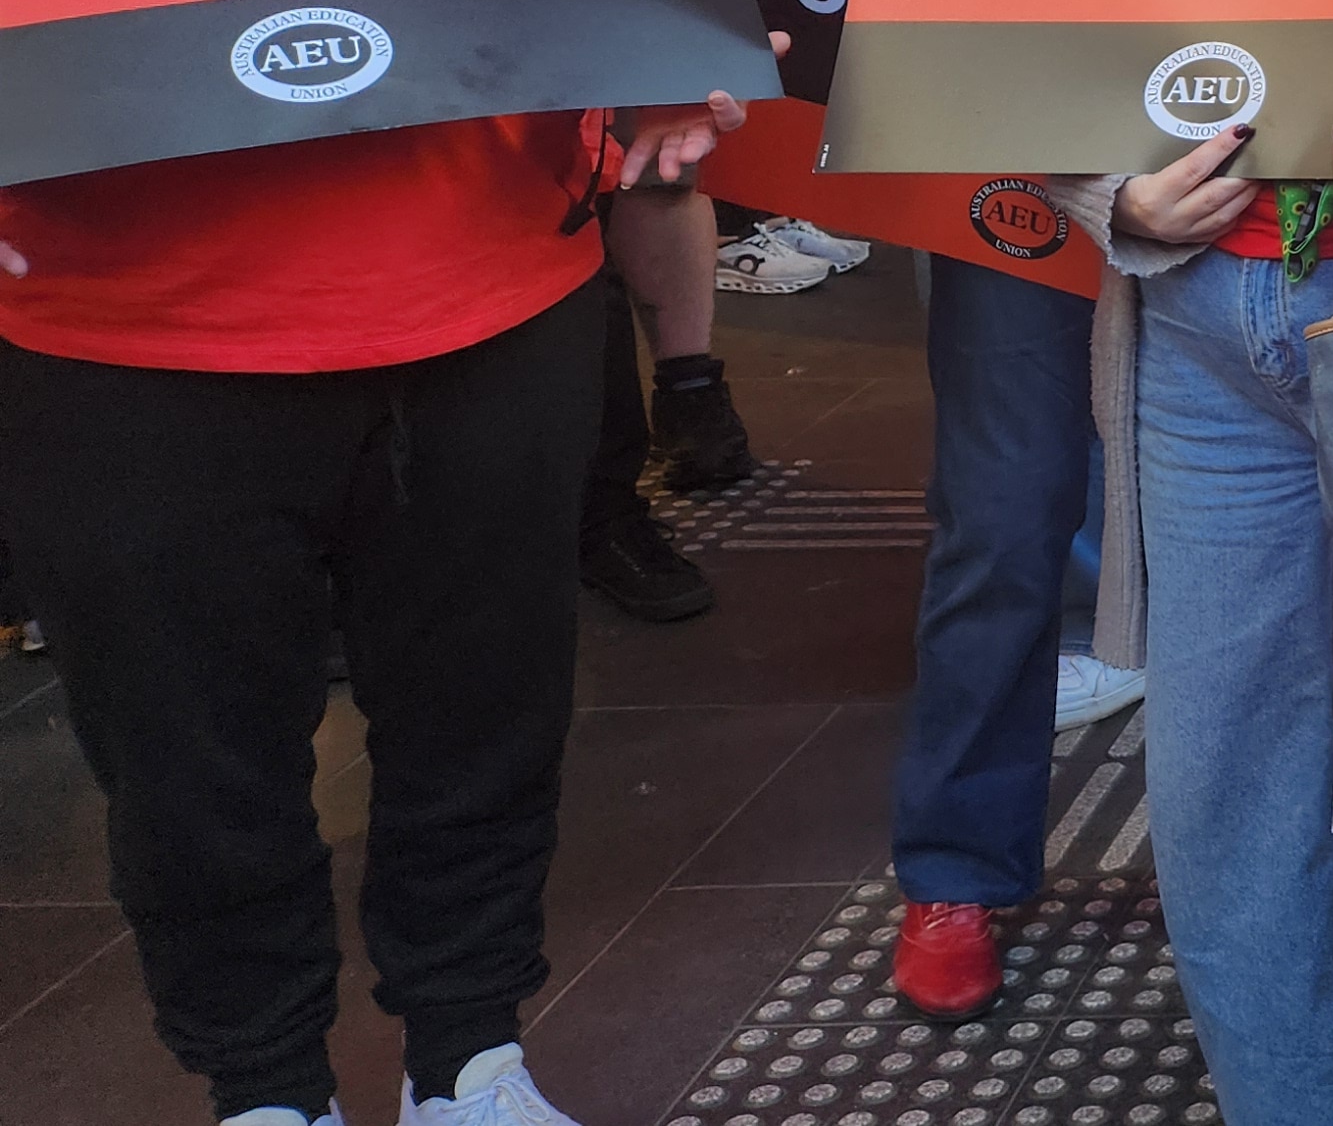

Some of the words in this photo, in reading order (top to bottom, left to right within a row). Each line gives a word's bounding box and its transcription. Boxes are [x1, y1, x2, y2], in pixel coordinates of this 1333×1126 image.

[235, 11, 303, 77] AUSTRALIAN
[307, 10, 389, 58] EDUCATION
[260, 36, 361, 72] AEU
[290, 83, 348, 100] UNION
[1148, 45, 1211, 105] AUSTRALIAN
[1213, 44, 1263, 103] EDUCATION
[1163, 76, 1246, 104] AEU
[1176, 124, 1221, 137] UNION
[971, 179, 1024, 220] AUSTRALIAN
[985, 200, 1051, 236] AEU
[995, 239, 1031, 257] UNION
